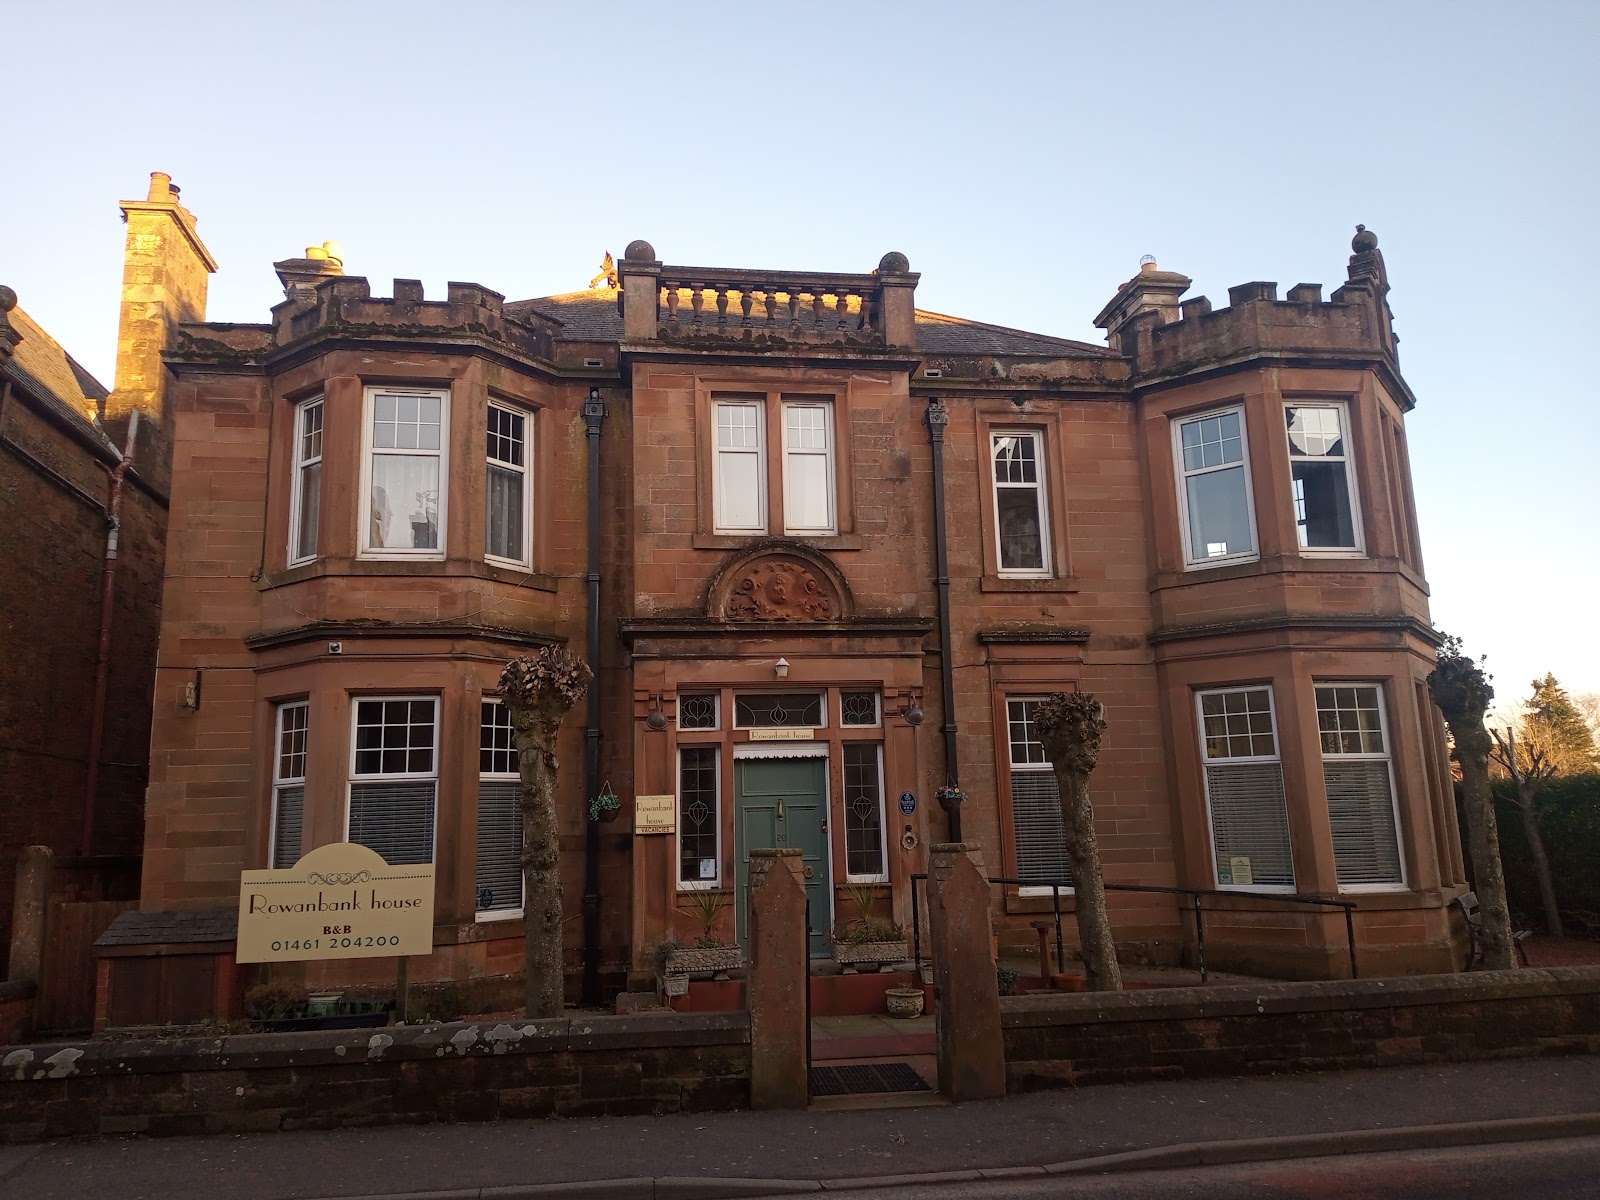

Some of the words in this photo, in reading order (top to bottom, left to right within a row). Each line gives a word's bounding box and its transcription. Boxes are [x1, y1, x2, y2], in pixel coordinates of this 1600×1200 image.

[751, 731, 790, 739] Rowanbank
[636, 801, 673, 812] Rowanbank
[646, 814, 664, 824] house
[776, 833, 786, 842] 20
[249, 891, 361, 914] Rowanbank
[371, 889, 422, 910] house
[322, 925, 352, 935] B&B
[271, 939, 319, 951] 01461
[329, 935, 400, 949] 204200
